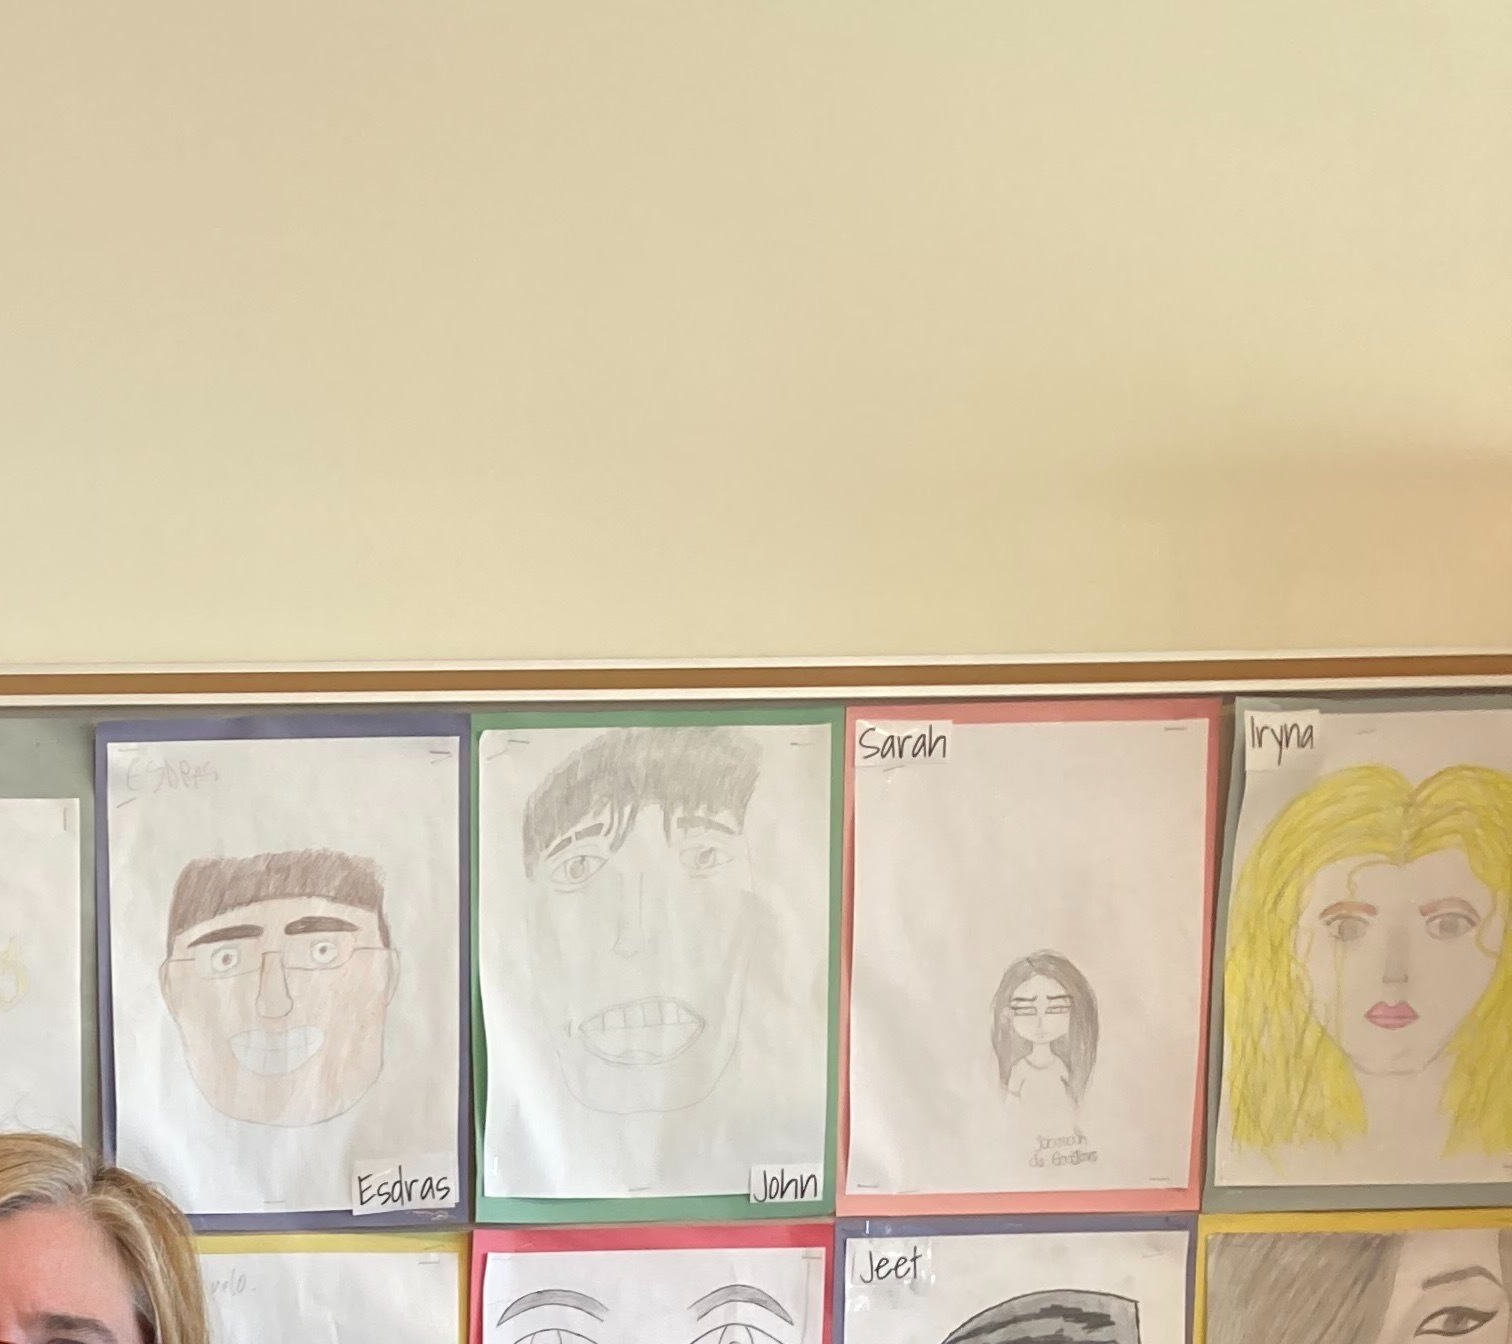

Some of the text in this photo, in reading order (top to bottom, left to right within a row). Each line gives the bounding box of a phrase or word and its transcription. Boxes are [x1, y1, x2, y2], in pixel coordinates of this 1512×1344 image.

[858, 726, 948, 760] Sarah
[1251, 716, 1313, 765] Iryna
[358, 1166, 451, 1206] Esdras
[753, 1168, 818, 1203] John
[859, 1246, 924, 1284] Jeet
